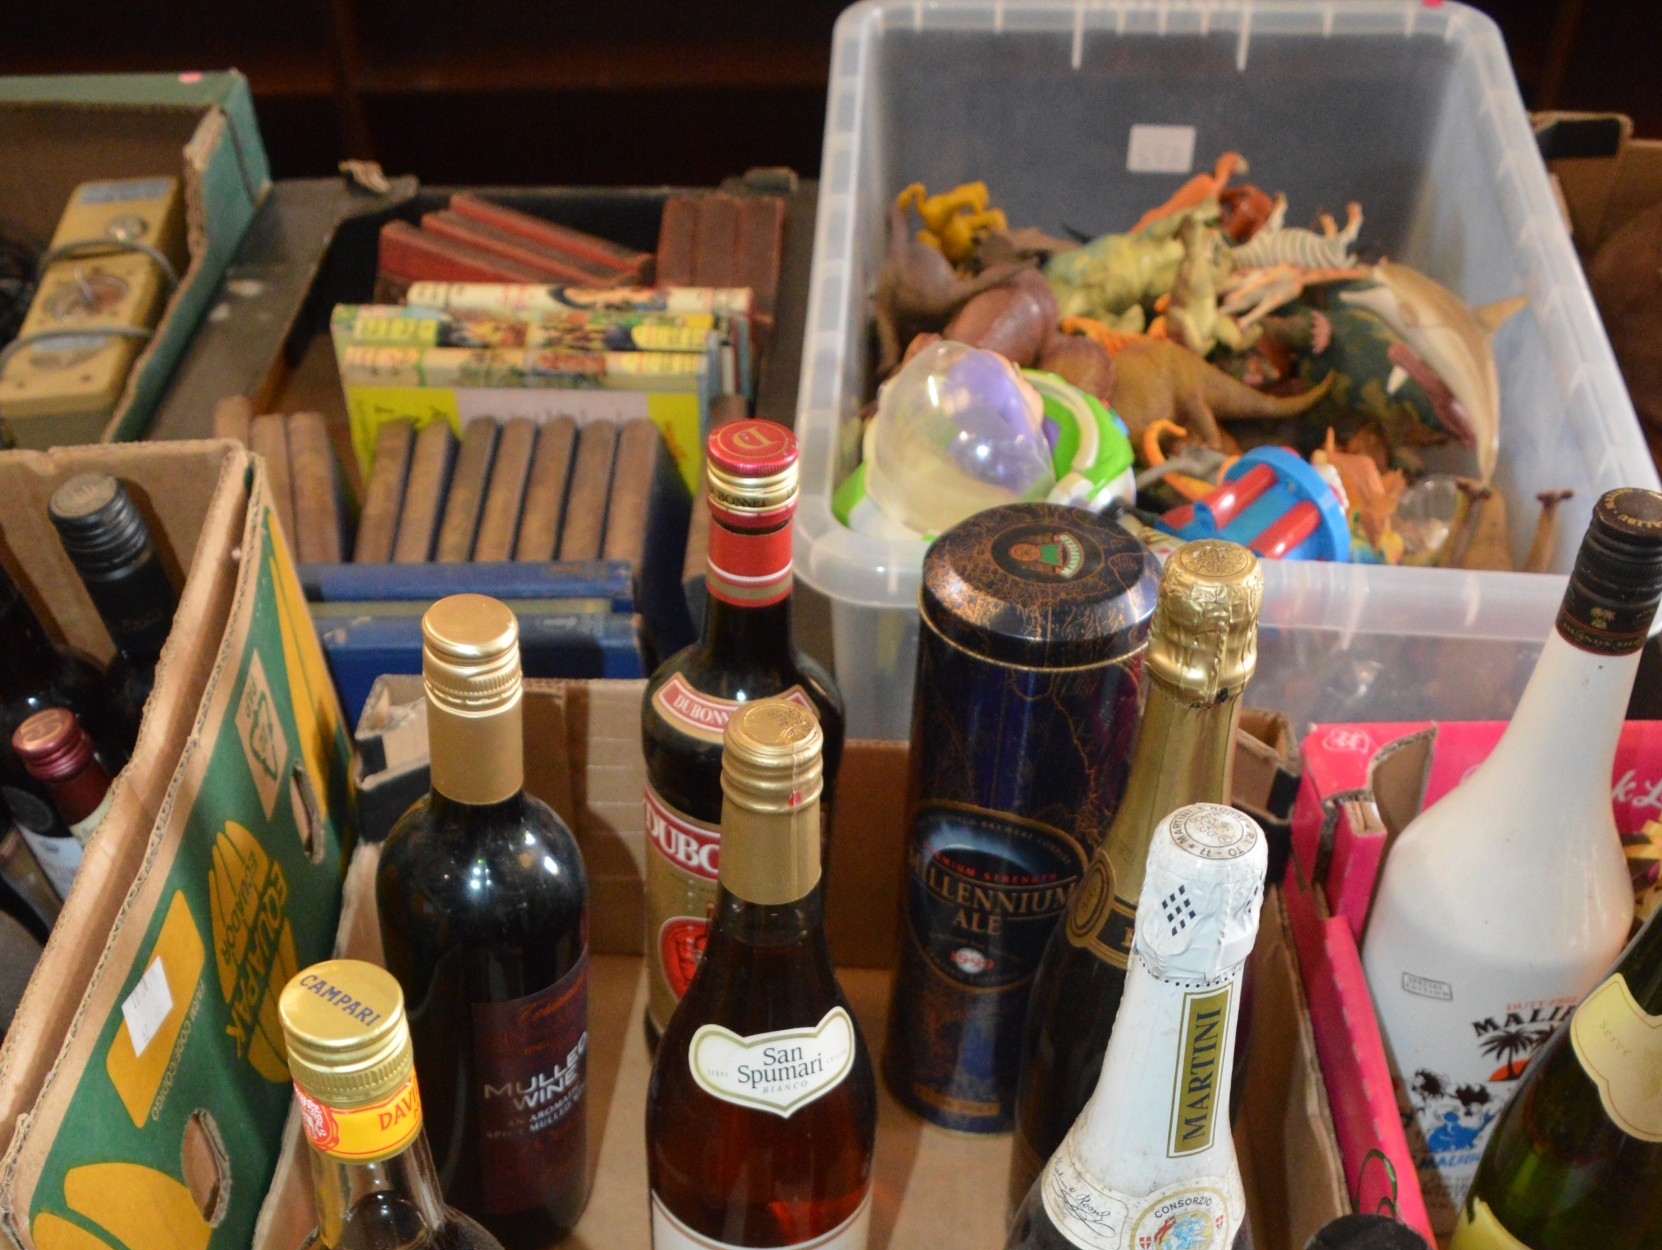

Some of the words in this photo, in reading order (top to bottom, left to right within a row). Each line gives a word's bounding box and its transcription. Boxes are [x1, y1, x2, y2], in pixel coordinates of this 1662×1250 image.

[645, 806, 720, 874] DUBO
[953, 909, 1002, 936] ALE
[225, 860, 288, 1058] EQUAPAK
[299, 973, 382, 1028] CAMPARI
[483, 1030, 589, 1099] MULLED
[737, 1052, 824, 1089] Spumari
[763, 1045, 805, 1067] San
[1182, 1007, 1222, 1141] MARTINI
[513, 1063, 578, 1112] WINE
[762, 1079, 809, 1095] BIANCO
[1154, 1196, 1214, 1219] CONSORZIO
